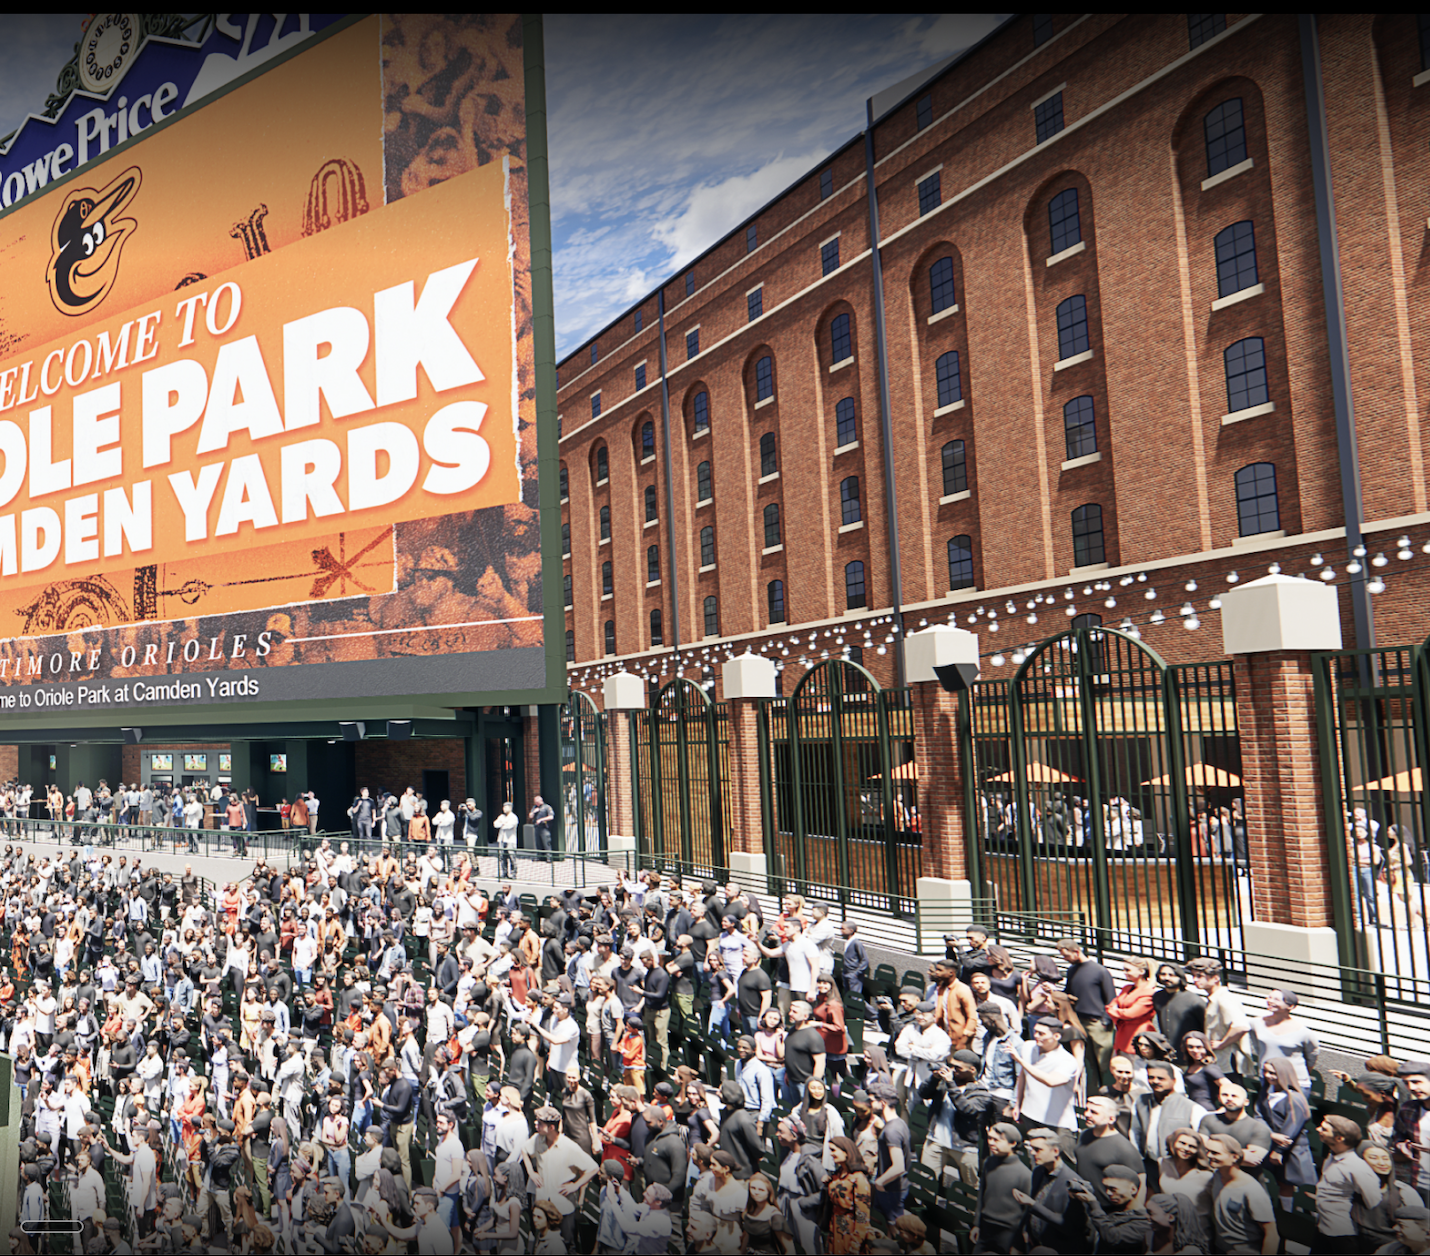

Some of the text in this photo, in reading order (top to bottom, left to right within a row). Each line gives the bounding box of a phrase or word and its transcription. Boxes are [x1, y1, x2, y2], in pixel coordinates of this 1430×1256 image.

[176, 281, 242, 348] TO
[142, 258, 487, 469] PARK
[167, 400, 491, 542] YARDS
[121, 631, 272, 668] ORIOLES
[19, 690, 32, 708] to
[34, 687, 74, 707] Oriole
[77, 684, 111, 705] Park
[114, 683, 130, 703] at
[133, 679, 202, 702] Camden
[205, 675, 260, 698] Yards
